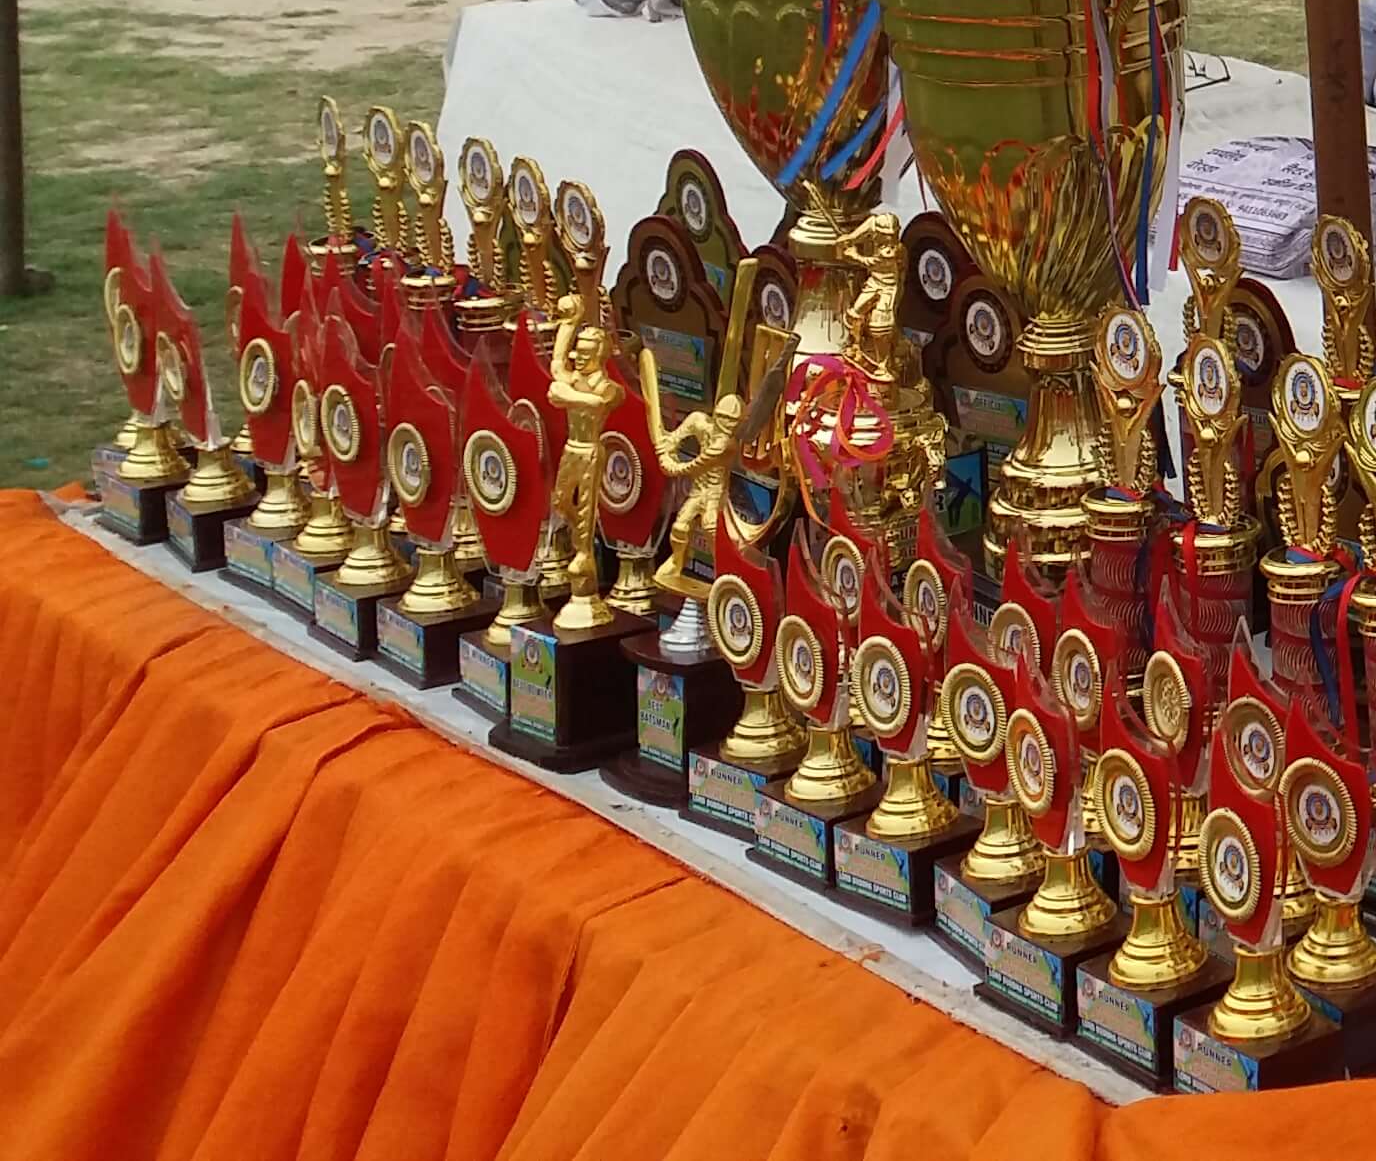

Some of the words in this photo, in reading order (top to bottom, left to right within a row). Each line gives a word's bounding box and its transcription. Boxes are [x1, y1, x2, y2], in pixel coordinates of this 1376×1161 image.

[640, 711, 671, 730] BATSMAN
[711, 769, 743, 784] RUNNER
[775, 811, 804, 828] RUNNER
[855, 843, 886, 861] RUNNER
[873, 883, 892, 898] SPORTS
[893, 891, 907, 903] CLUB
[1098, 990, 1129, 1011] RUNNER
[1198, 1042, 1232, 1067] RUNNER
